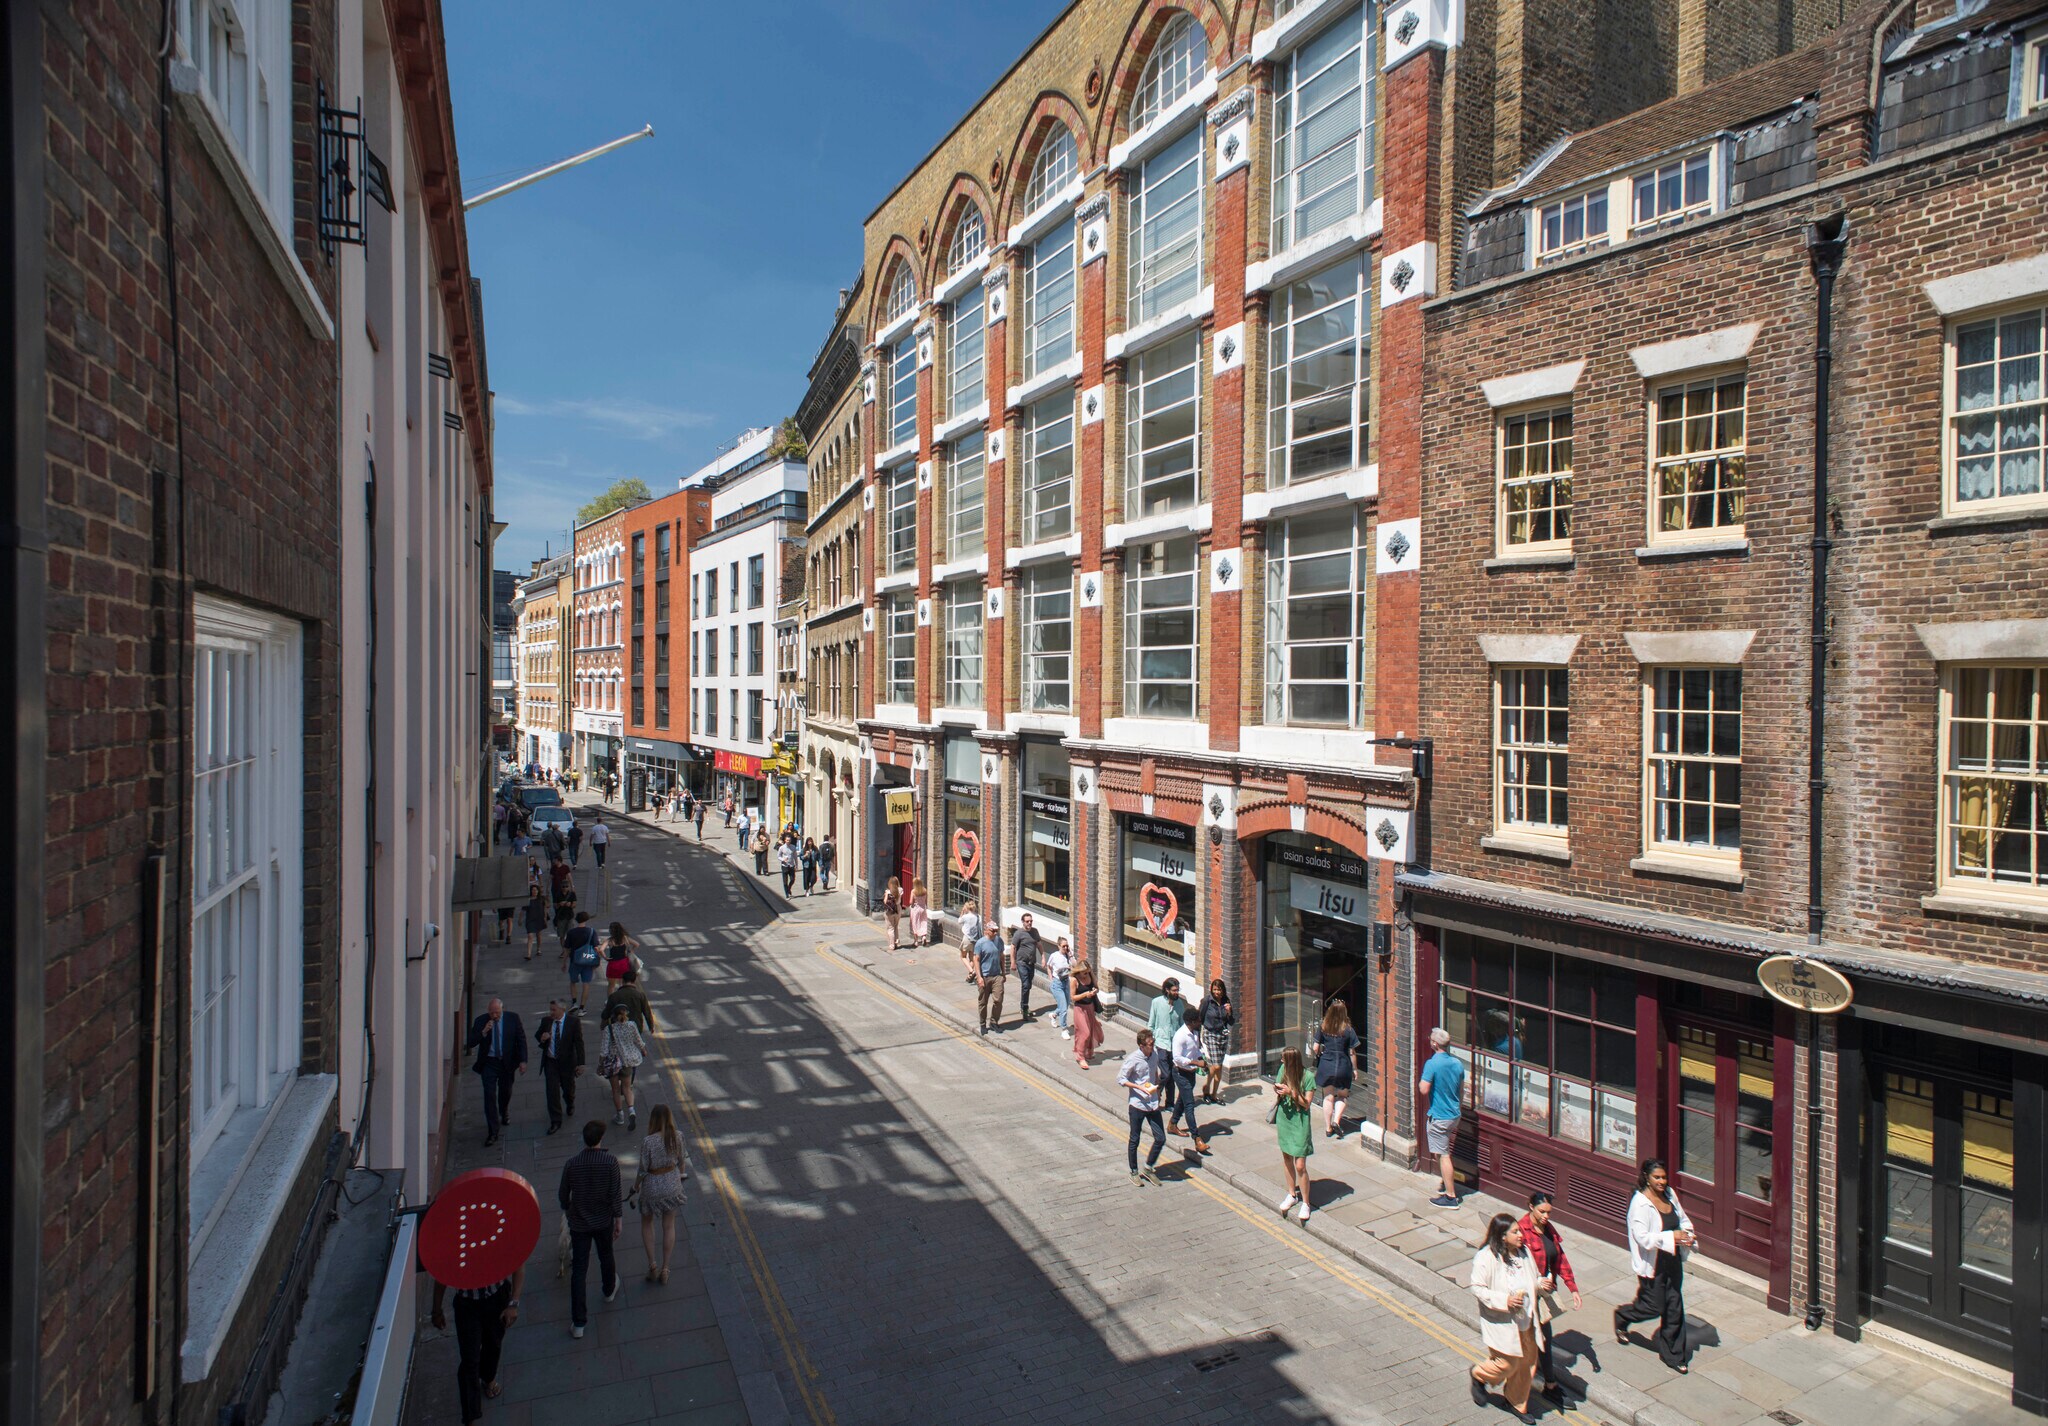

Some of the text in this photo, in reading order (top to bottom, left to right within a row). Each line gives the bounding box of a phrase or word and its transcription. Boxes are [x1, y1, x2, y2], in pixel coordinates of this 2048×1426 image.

[731, 754, 748, 773] LEON
[891, 803, 909, 813] itsu
[1053, 825, 1070, 847] itsu
[1133, 821, 1185, 840] gyoza hot noodles
[1160, 851, 1185, 877] itsu
[1283, 851, 1362, 876] asian salads sushi
[1319, 885, 1355, 916] itsu
[1774, 981, 1840, 1005] ROOKERY
[460, 1202, 506, 1268] P
